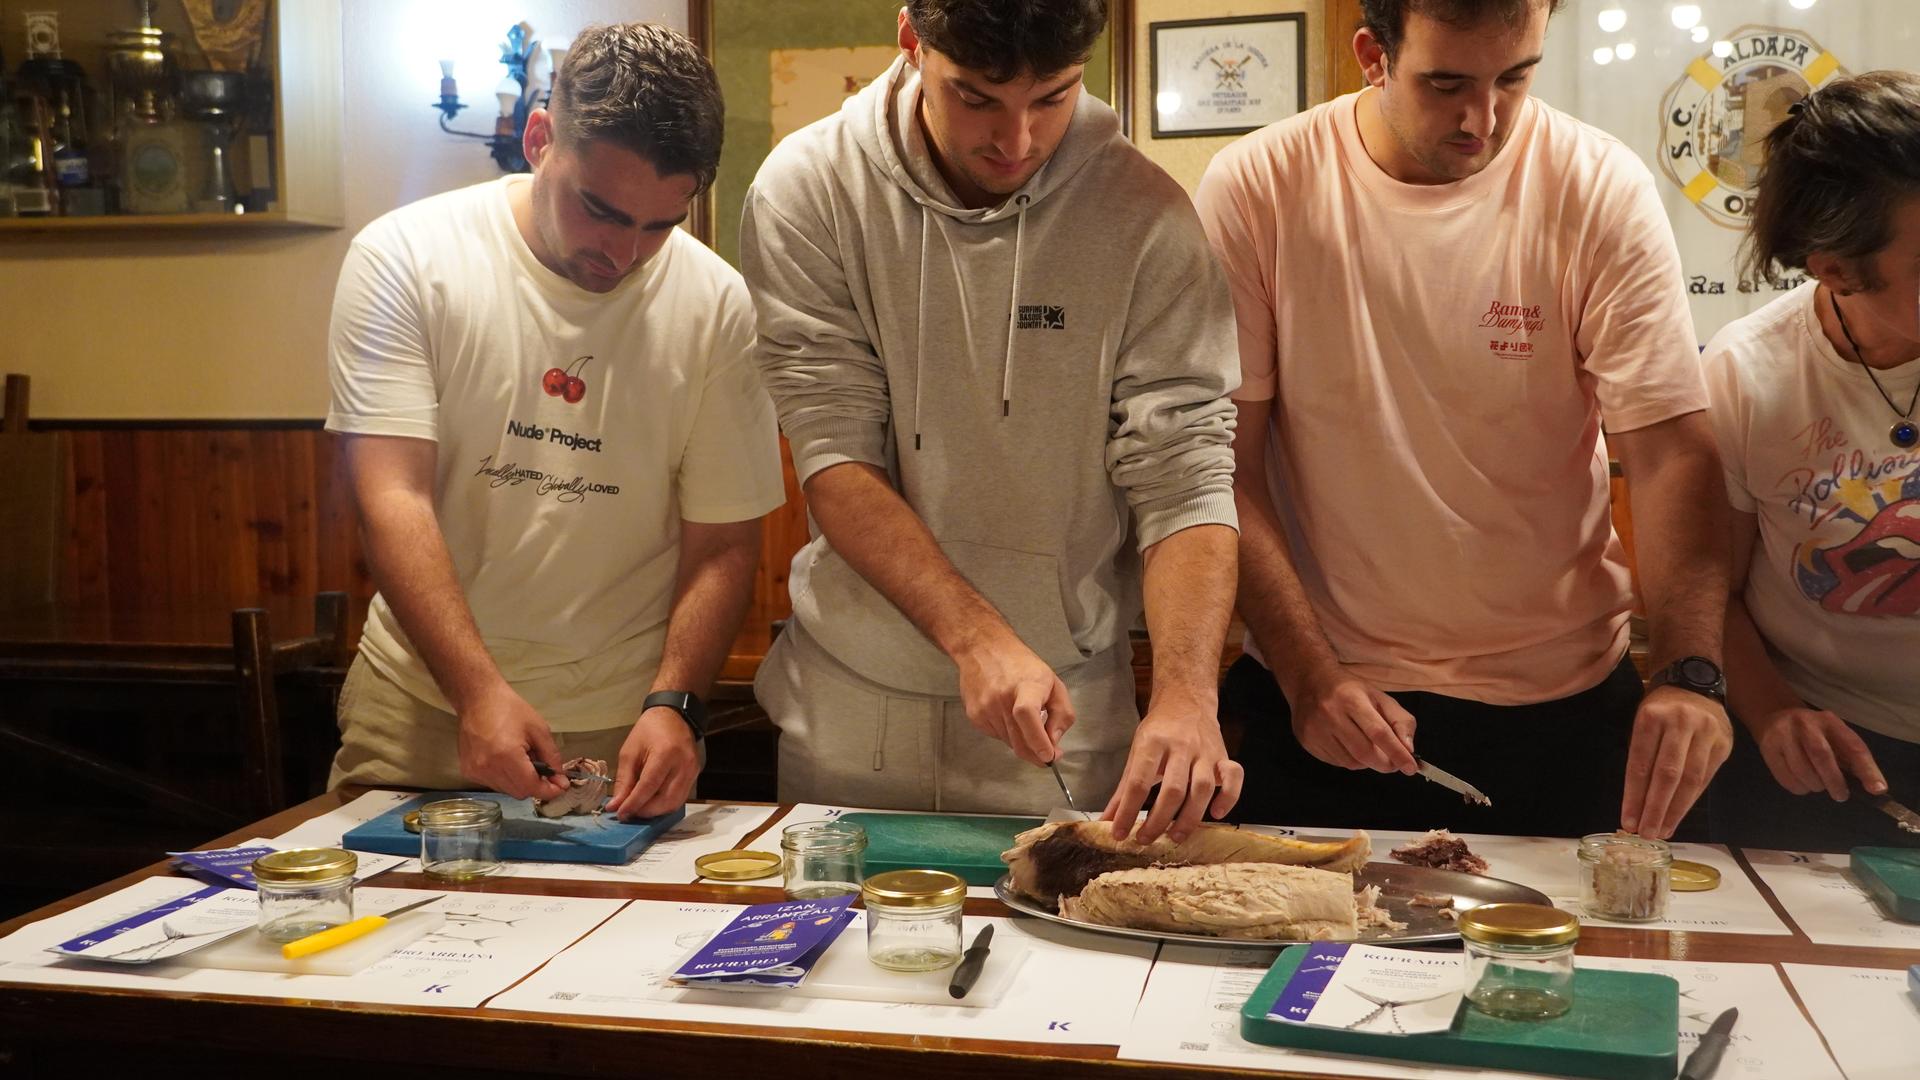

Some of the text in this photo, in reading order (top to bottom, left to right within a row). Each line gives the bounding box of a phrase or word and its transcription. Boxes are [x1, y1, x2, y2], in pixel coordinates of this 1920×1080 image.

[1018, 305, 1042, 313] SURFING
[1019, 313, 1042, 321] BASQUE
[550, 428, 602, 452] Project
[1791, 416, 1848, 459] The
[515, 468, 543, 481] HATED
[589, 482, 620, 495] LOVED
[740, 906, 840, 922] ARRANTZALE
[777, 903, 816, 912] IZAN
